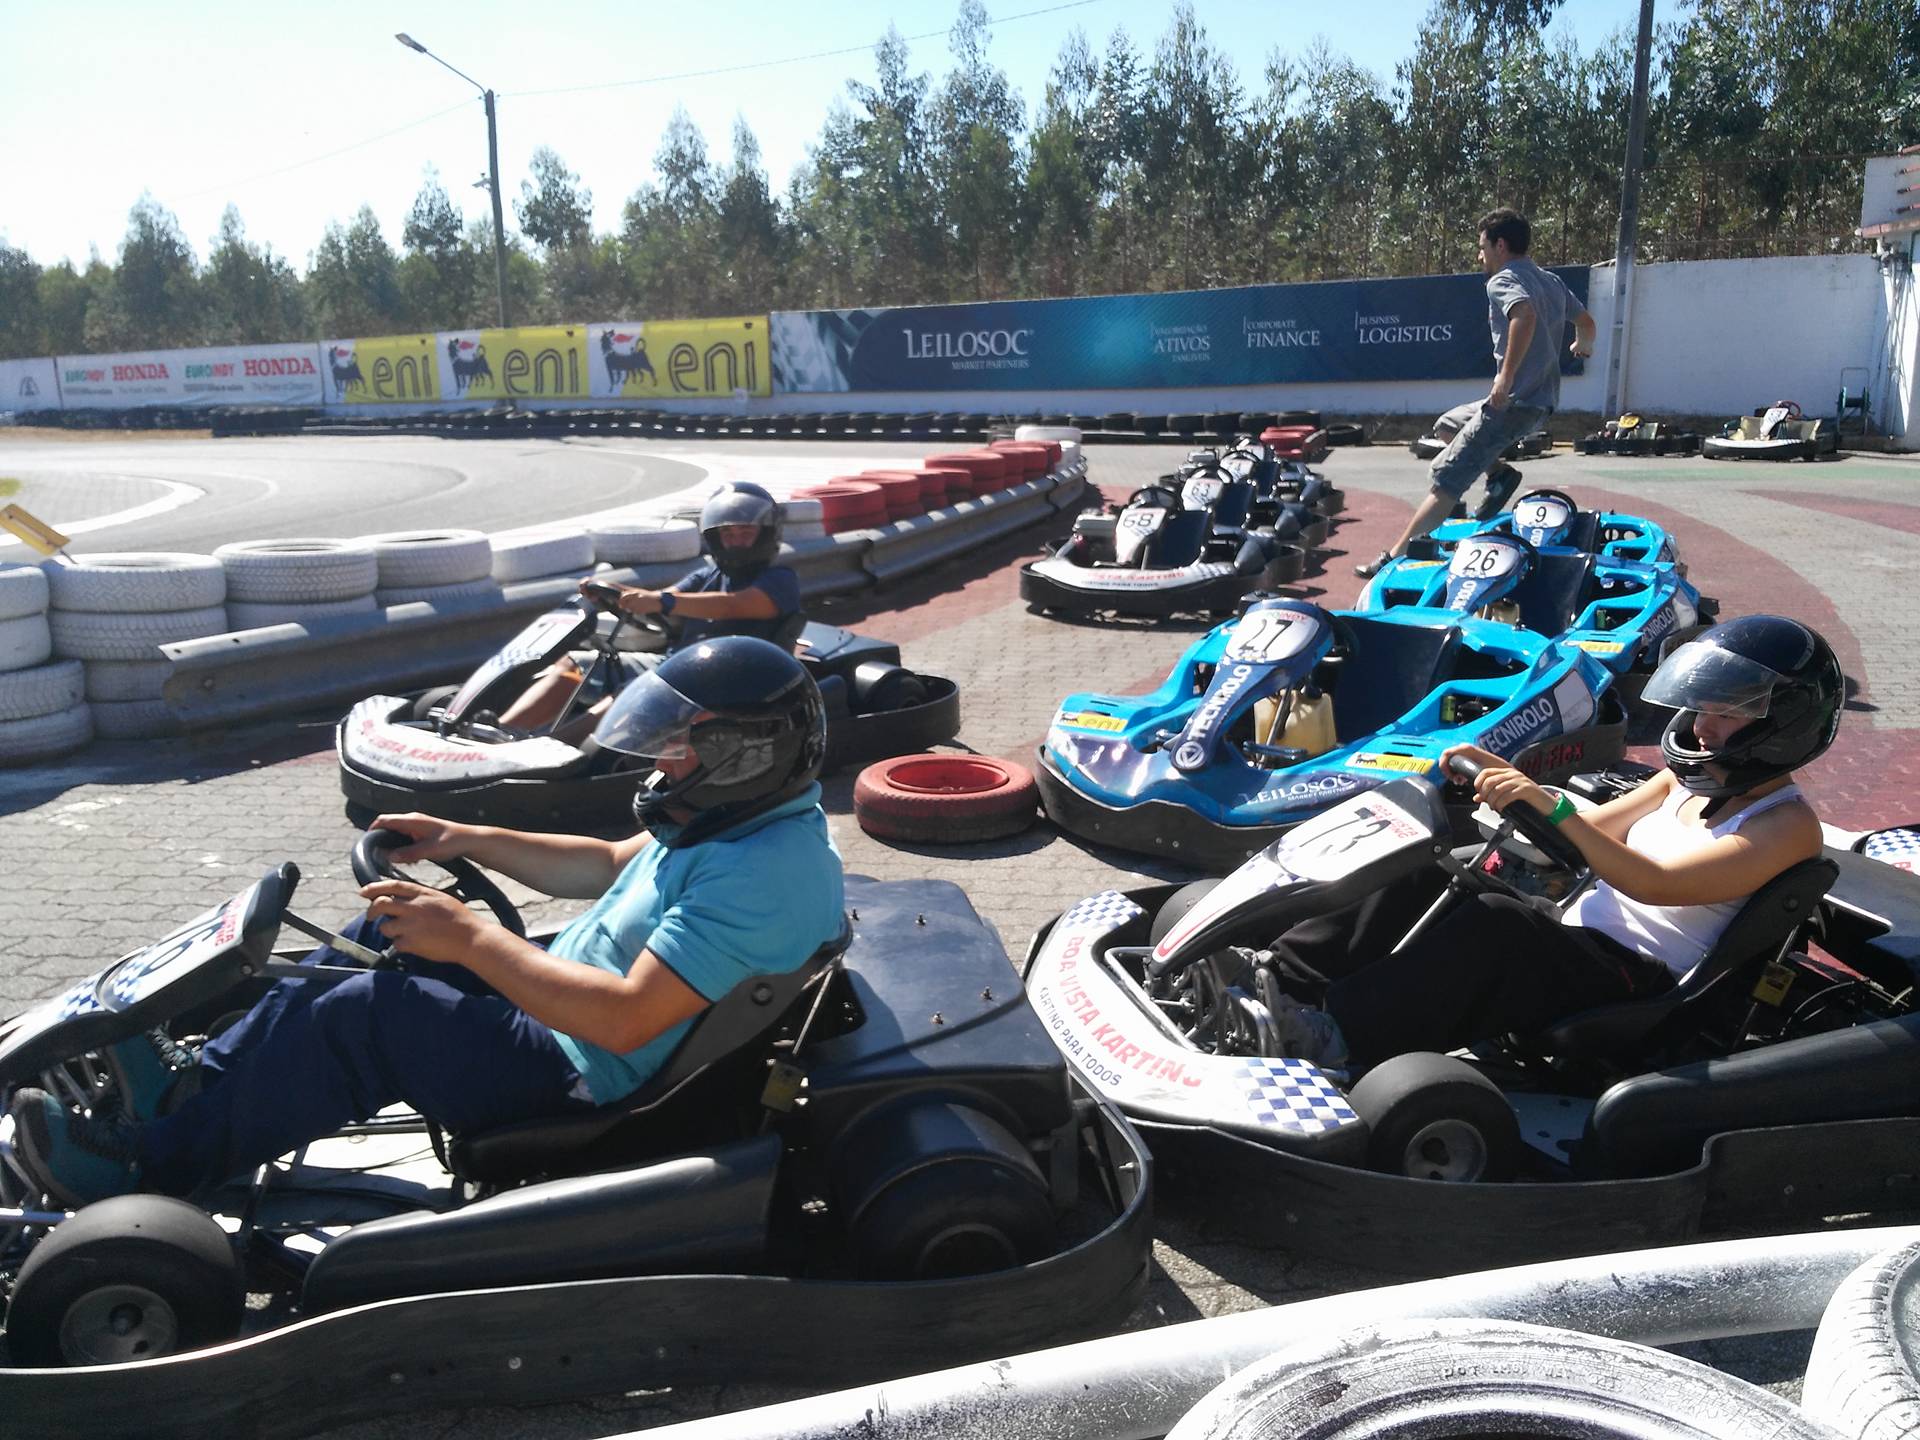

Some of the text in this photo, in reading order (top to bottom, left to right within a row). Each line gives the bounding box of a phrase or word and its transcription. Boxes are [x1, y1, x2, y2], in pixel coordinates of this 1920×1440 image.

[1359, 324, 1453, 345] LOGISTICS
[1360, 314, 1400, 326] BUSINESS
[903, 329, 1029, 359] LEILOSOC
[1153, 335, 1211, 353] ATIVOS
[1247, 330, 1321, 349] FINANCE
[242, 356, 317, 377] HONDA
[371, 338, 433, 400] eni
[503, 330, 580, 394] eni
[668, 321, 758, 393] eni
[112, 363, 170, 382] HONDA
[1122, 512, 1155, 528] 68
[1535, 506, 1548, 523] 9
[1462, 549, 1500, 572] 26
[1238, 618, 1294, 652] 27
[1187, 665, 1252, 741] TECNIROLO
[1480, 697, 1555, 754] TECNIROLO
[1382, 759, 1427, 774] eni
[1238, 773, 1355, 805] LEILOSOC
[1059, 935, 1085, 973] BOA
[1059, 975, 1101, 1027] VISTA
[1059, 1027, 1085, 1057] PARA
[1080, 1053, 1123, 1087] TODOS
